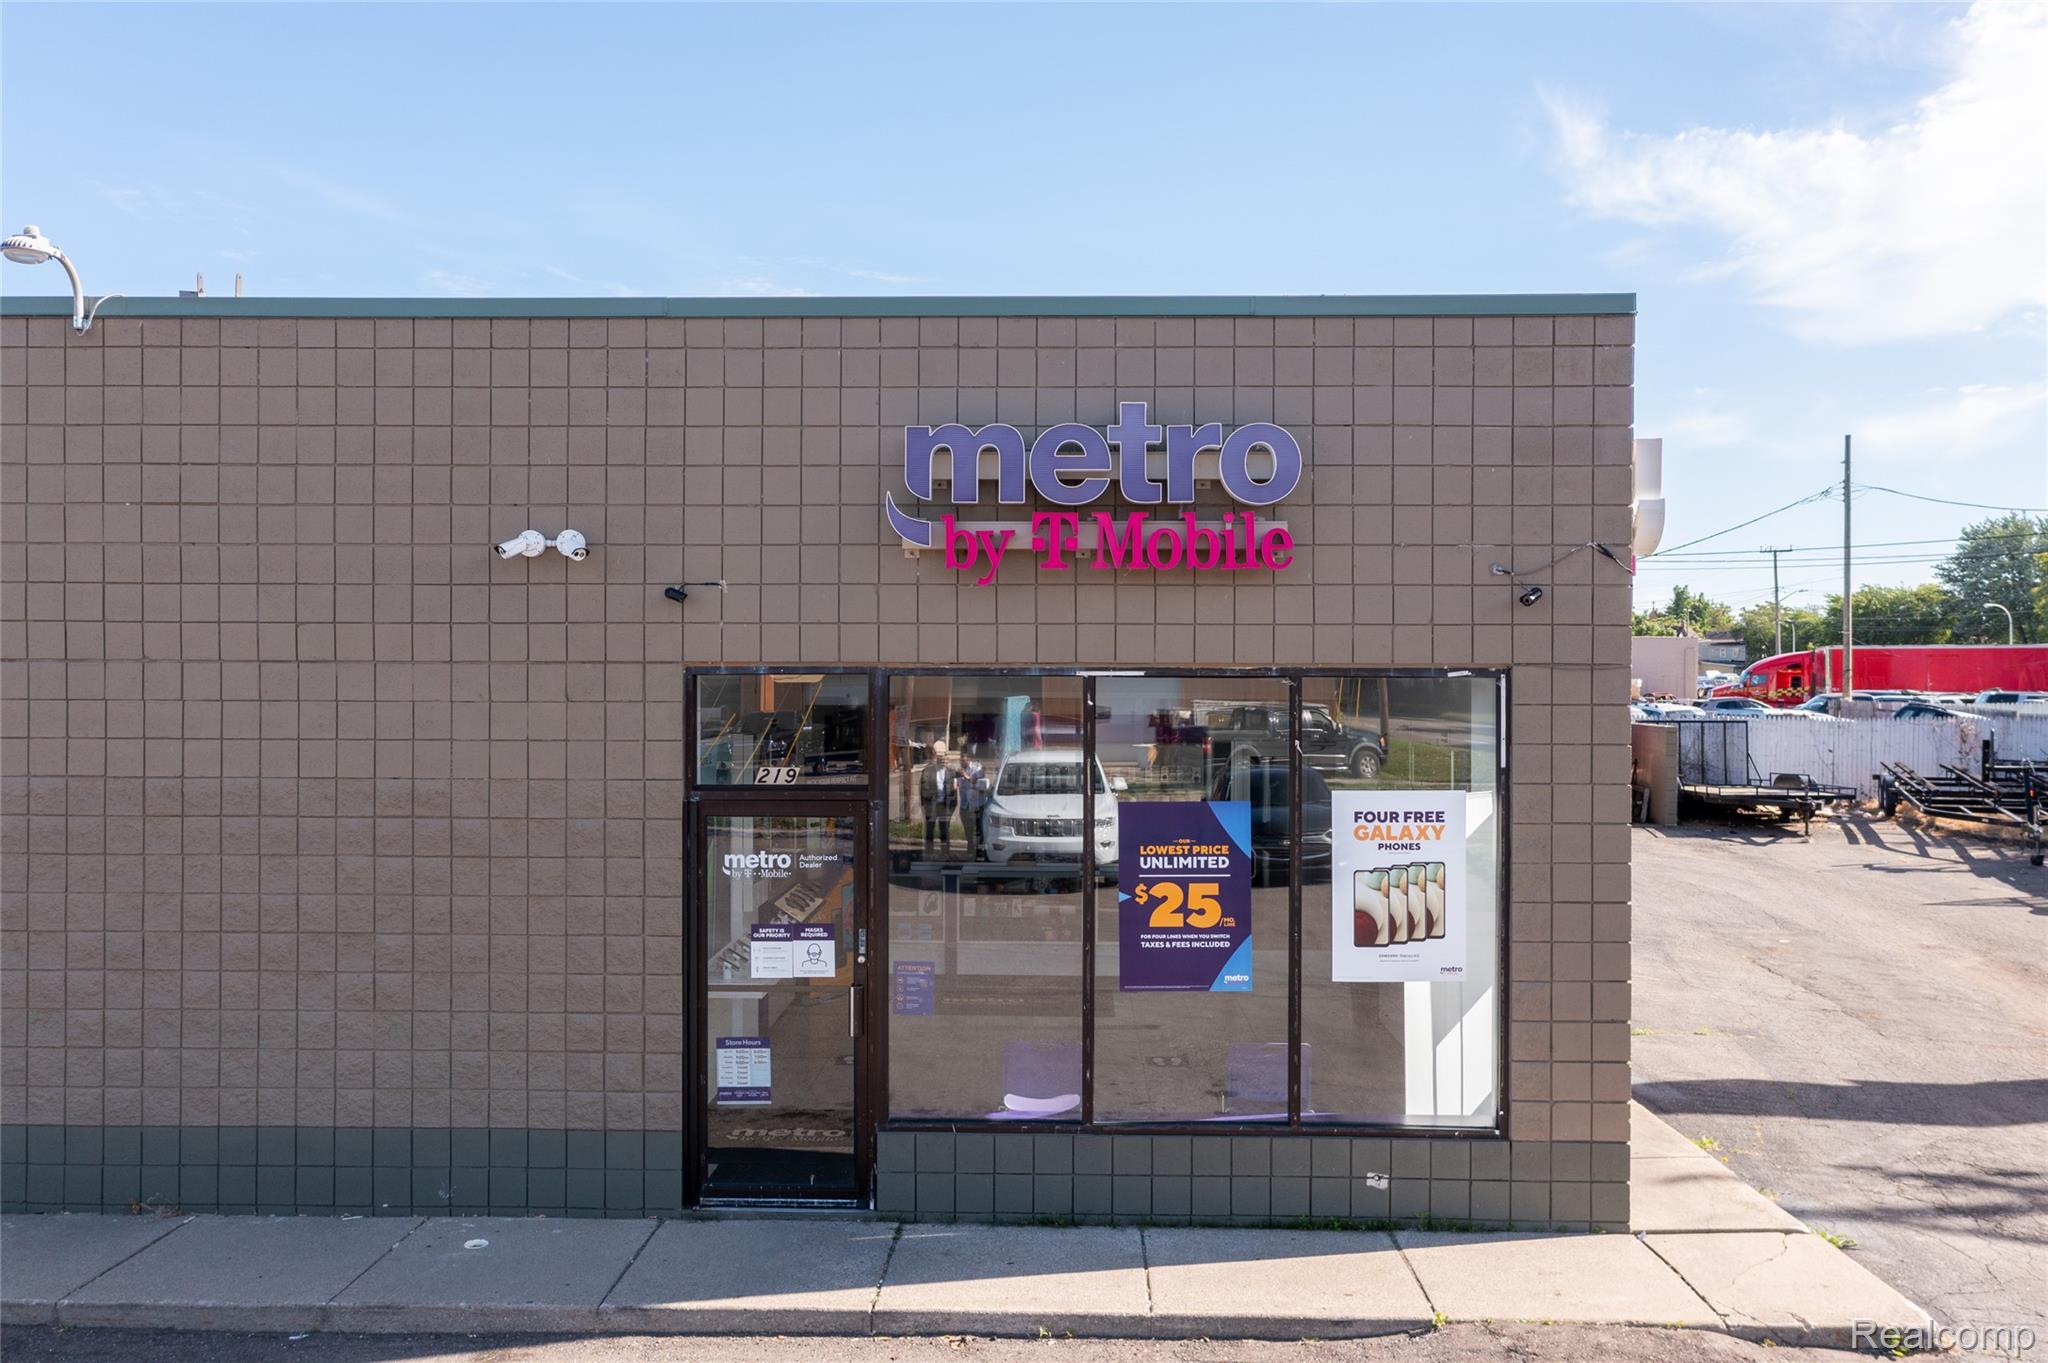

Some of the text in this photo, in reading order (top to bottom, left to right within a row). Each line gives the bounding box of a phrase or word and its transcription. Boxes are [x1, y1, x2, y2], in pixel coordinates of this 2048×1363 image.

[905, 402, 1302, 504] metro
[941, 514, 1015, 586] by
[758, 768, 797, 783] 219
[1354, 811, 1445, 823] FOUR FREE
[1353, 825, 1446, 841] GALAXY
[1140, 845, 1230, 855] LOWEST PRICE
[724, 851, 791, 868] metro
[1140, 856, 1230, 869] UNLIMITED
[732, 869, 743, 880] by
[1135, 882, 1222, 928] $25
[1224, 974, 1249, 982] metro
